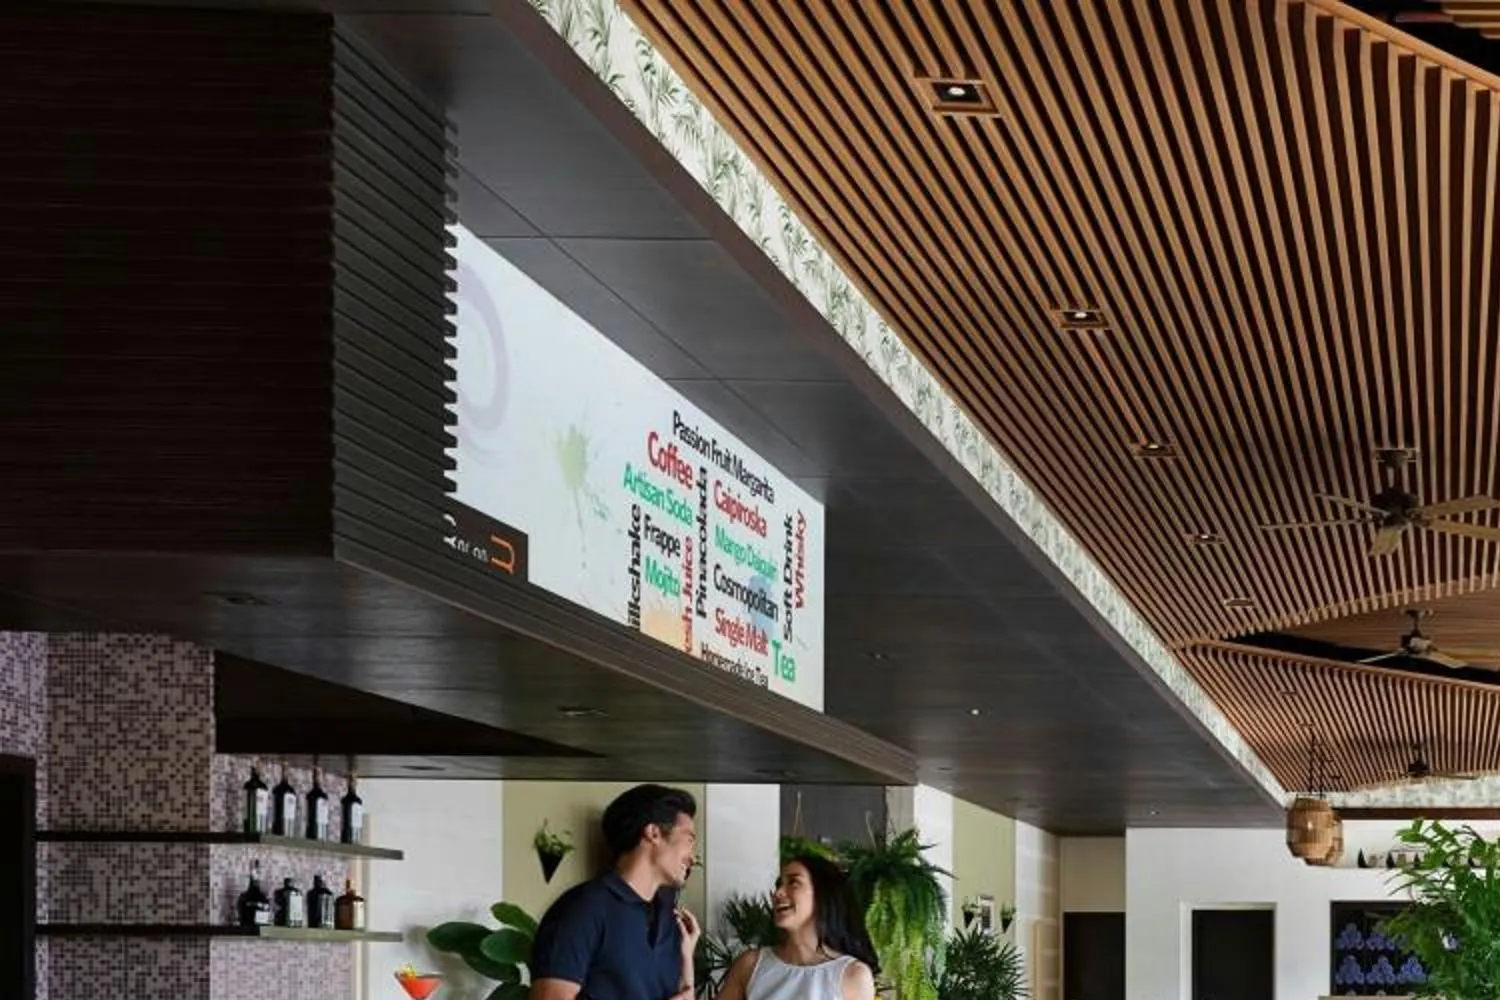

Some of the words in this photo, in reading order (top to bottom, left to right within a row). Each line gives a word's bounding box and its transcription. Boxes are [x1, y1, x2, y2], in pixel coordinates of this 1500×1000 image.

[647, 430, 693, 490] Coffee
[673, 409, 711, 460] Passion
[711, 438, 732, 475] Fruit
[733, 453, 775, 504] Margarita
[623, 461, 665, 511] Artisan
[666, 487, 693, 527] Soda
[714, 478, 767, 538] Caipiroska
[627, 503, 641, 629] ilkshake
[643, 513, 681, 559] Frappe
[715, 523, 746, 567] Mango
[783, 511, 793, 586] Drink
[794, 505, 806, 609] Whisky
[644, 555, 680, 598] Mojito
[681, 535, 693, 604] Juice
[713, 563, 779, 622] Cosmopolitan
[715, 607, 745, 648] Single
[746, 622, 769, 657] Malt
[783, 589, 793, 643] Soft
[771, 639, 796, 683] Tea
